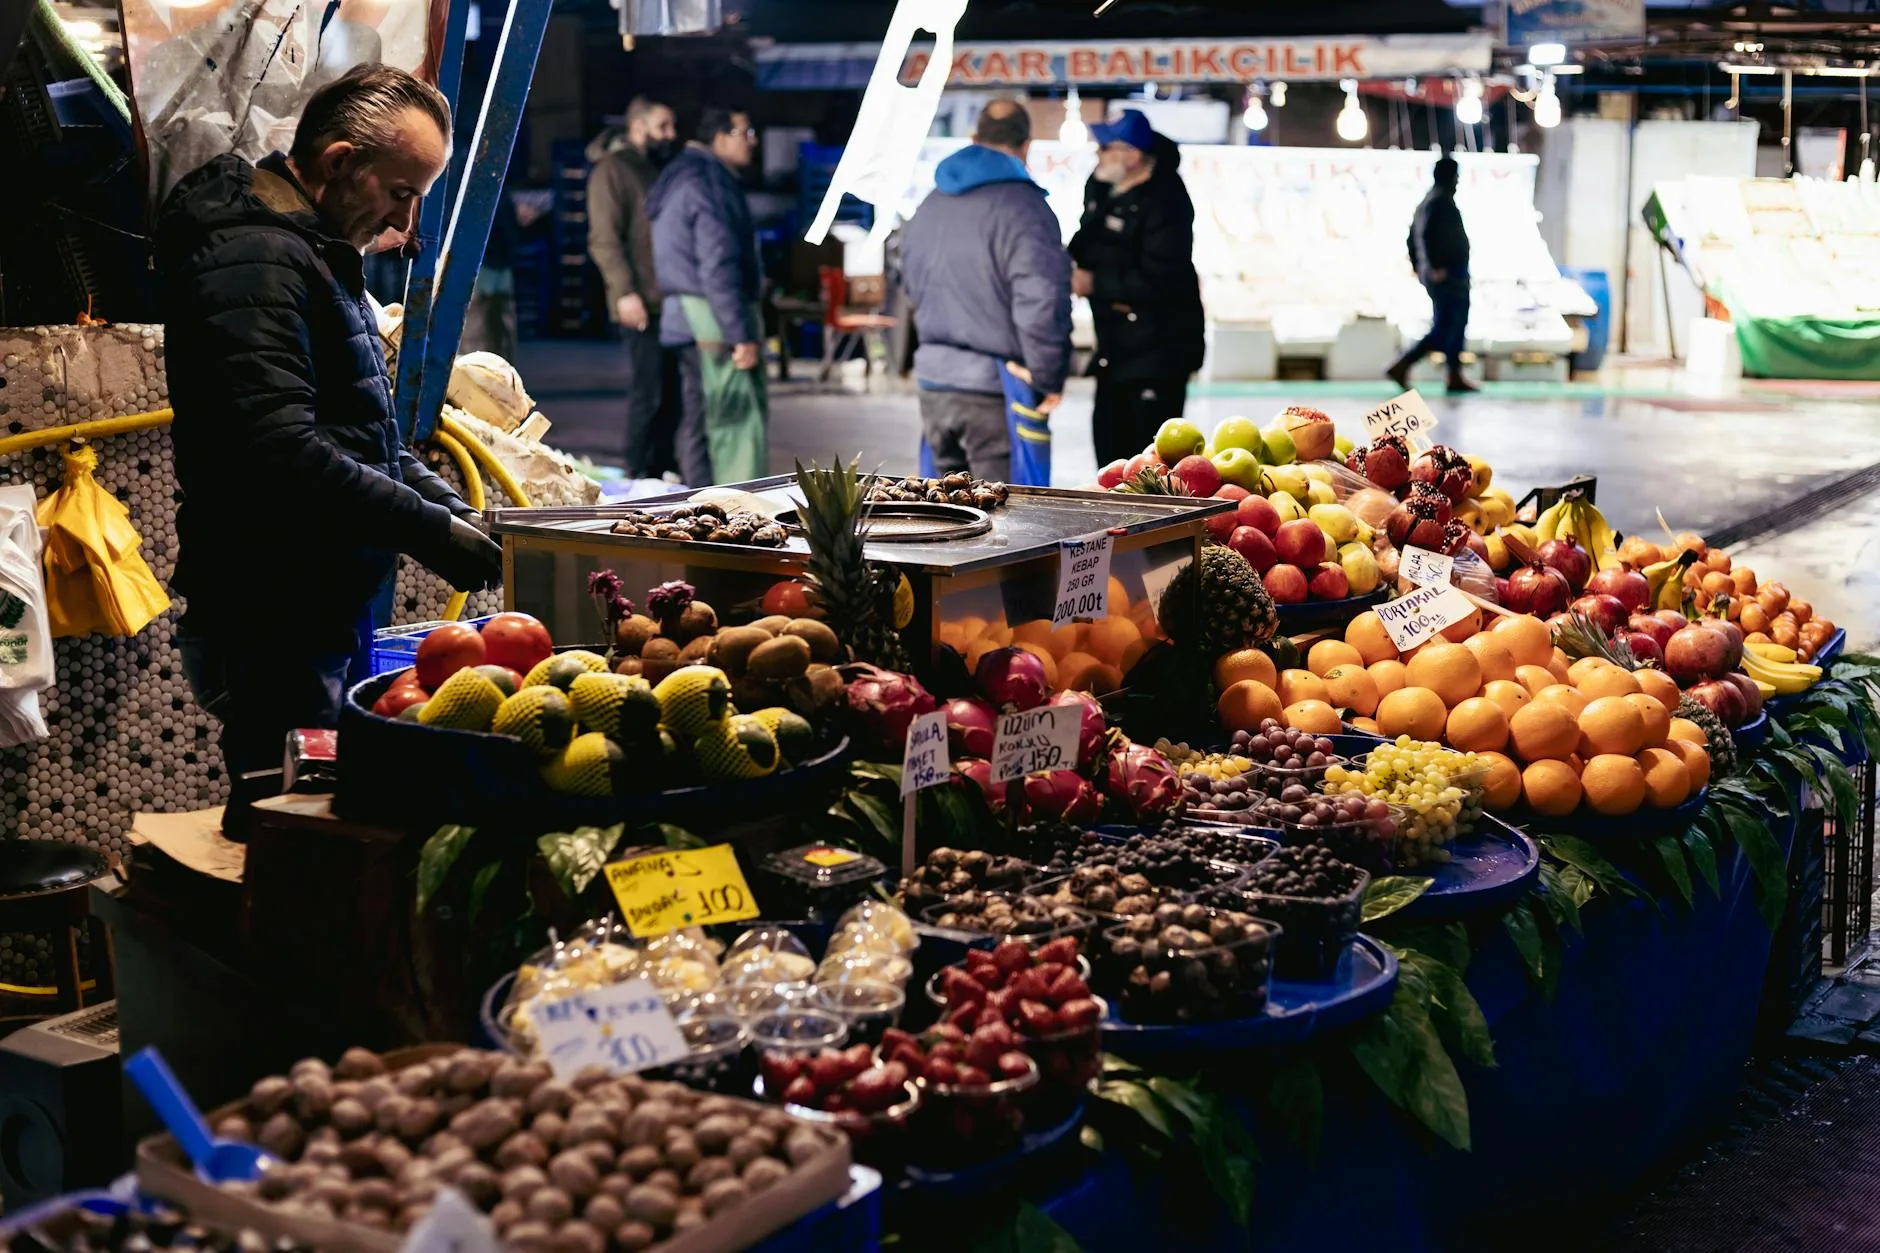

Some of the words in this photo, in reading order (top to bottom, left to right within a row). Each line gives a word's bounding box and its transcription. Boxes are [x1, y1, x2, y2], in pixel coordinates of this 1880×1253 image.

[1067, 42, 1368, 81] BALIKÇILIK
[1366, 402, 1405, 426] AYVA
[1384, 414, 1420, 436] 150
[1070, 537, 1107, 559] KESTANE
[1071, 556, 1100, 574] KEBAP
[1066, 578, 1080, 592] 250
[1081, 574, 1095, 587] GR
[1377, 587, 1447, 621] PORTAKAL
[1023, 744, 1062, 774] 150
[697, 883, 744, 919] 100
